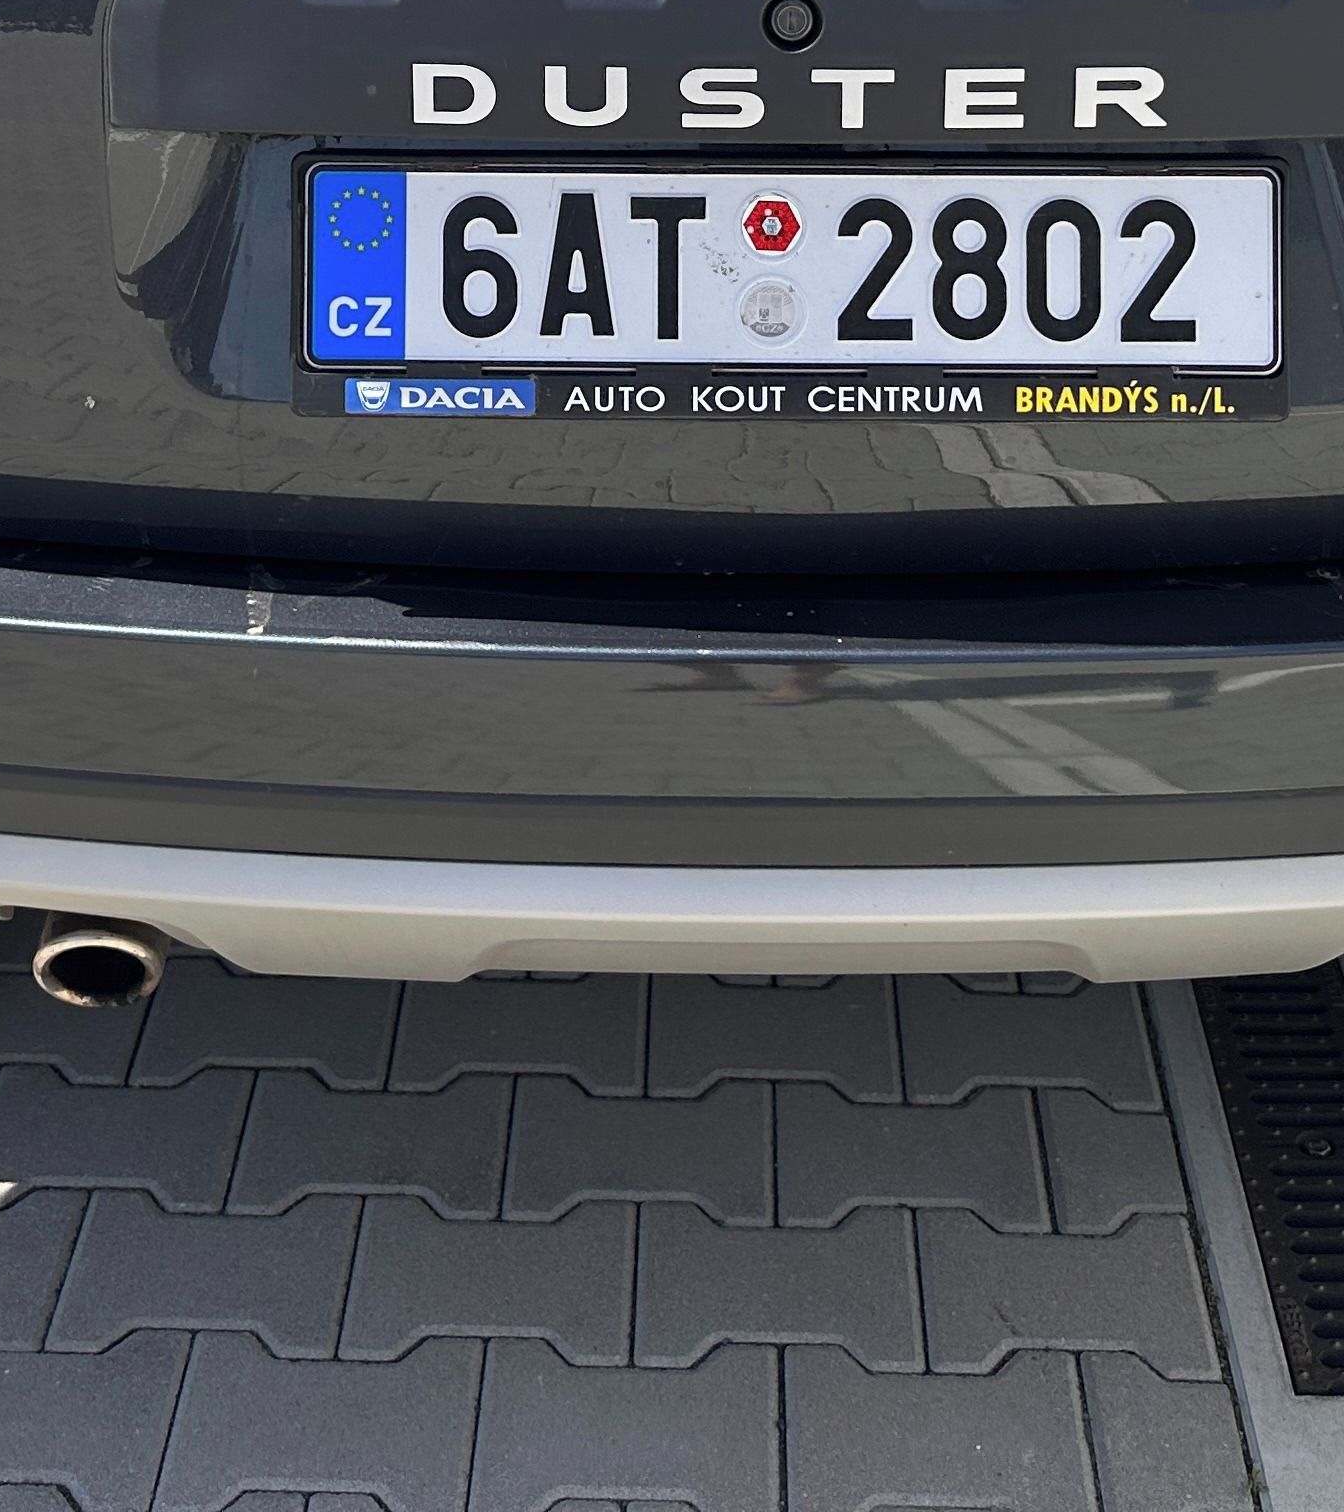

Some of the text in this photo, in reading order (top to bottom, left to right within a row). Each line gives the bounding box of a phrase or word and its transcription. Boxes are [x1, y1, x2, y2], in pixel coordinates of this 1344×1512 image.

[411, 63, 1168, 129] DUSTER
[442, 192, 1197, 342] 6AT 2802
[328, 295, 393, 338] CZ
[399, 380, 1236, 416] DACIA AUTO KOUT CENTRUM BRANDÝS n./L.
